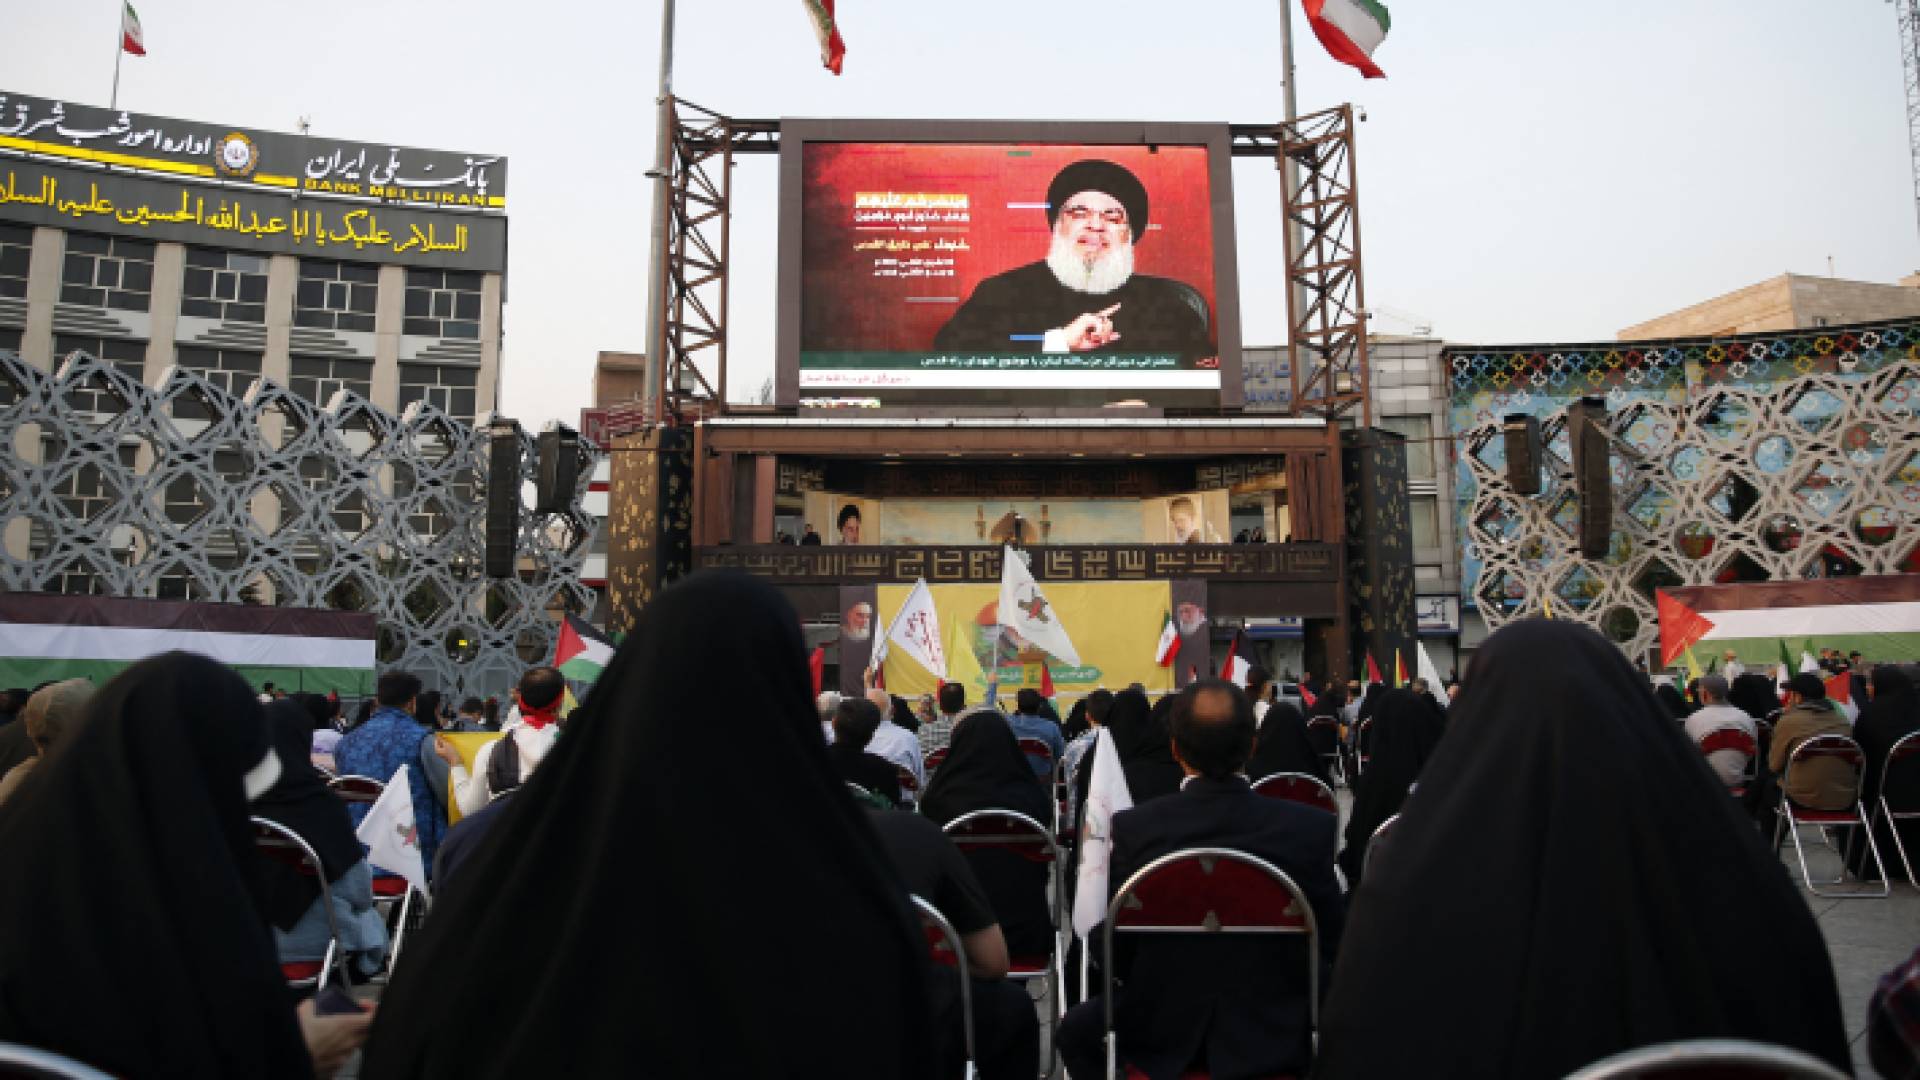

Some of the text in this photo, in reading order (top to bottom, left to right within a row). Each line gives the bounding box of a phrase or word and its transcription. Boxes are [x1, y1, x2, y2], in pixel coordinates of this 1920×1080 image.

[304, 147, 365, 179] ایران
[304, 177, 486, 205] BANK MELLI IRAN
